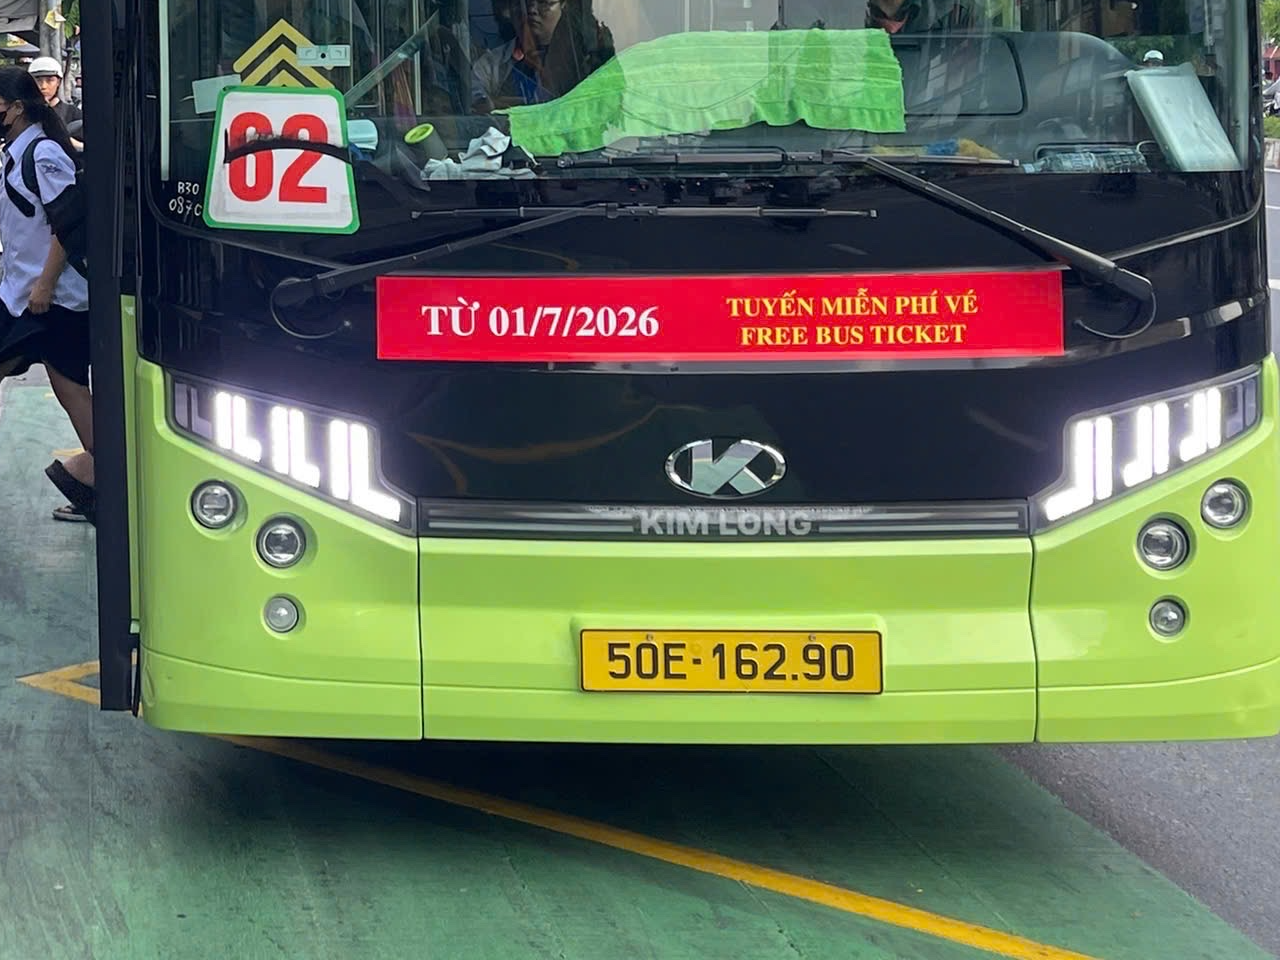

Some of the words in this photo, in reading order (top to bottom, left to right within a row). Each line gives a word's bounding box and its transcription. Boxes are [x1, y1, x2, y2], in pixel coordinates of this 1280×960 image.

[228, 111, 328, 203] 02
[422, 297, 480, 337] TỪ
[488, 306, 660, 338] 01/7/2026
[726, 291, 815, 317] TUYẾN
[821, 288, 891, 317] MIỄN
[895, 289, 940, 315] PHÍ
[944, 291, 978, 315] VÉ
[740, 326, 809, 346] FREE
[816, 326, 865, 346] BUS
[870, 324, 967, 345] TICKET
[640, 510, 708, 535] KIM
[720, 510, 812, 536] LONG
[607, 641, 855, 682] 50E-162.90
